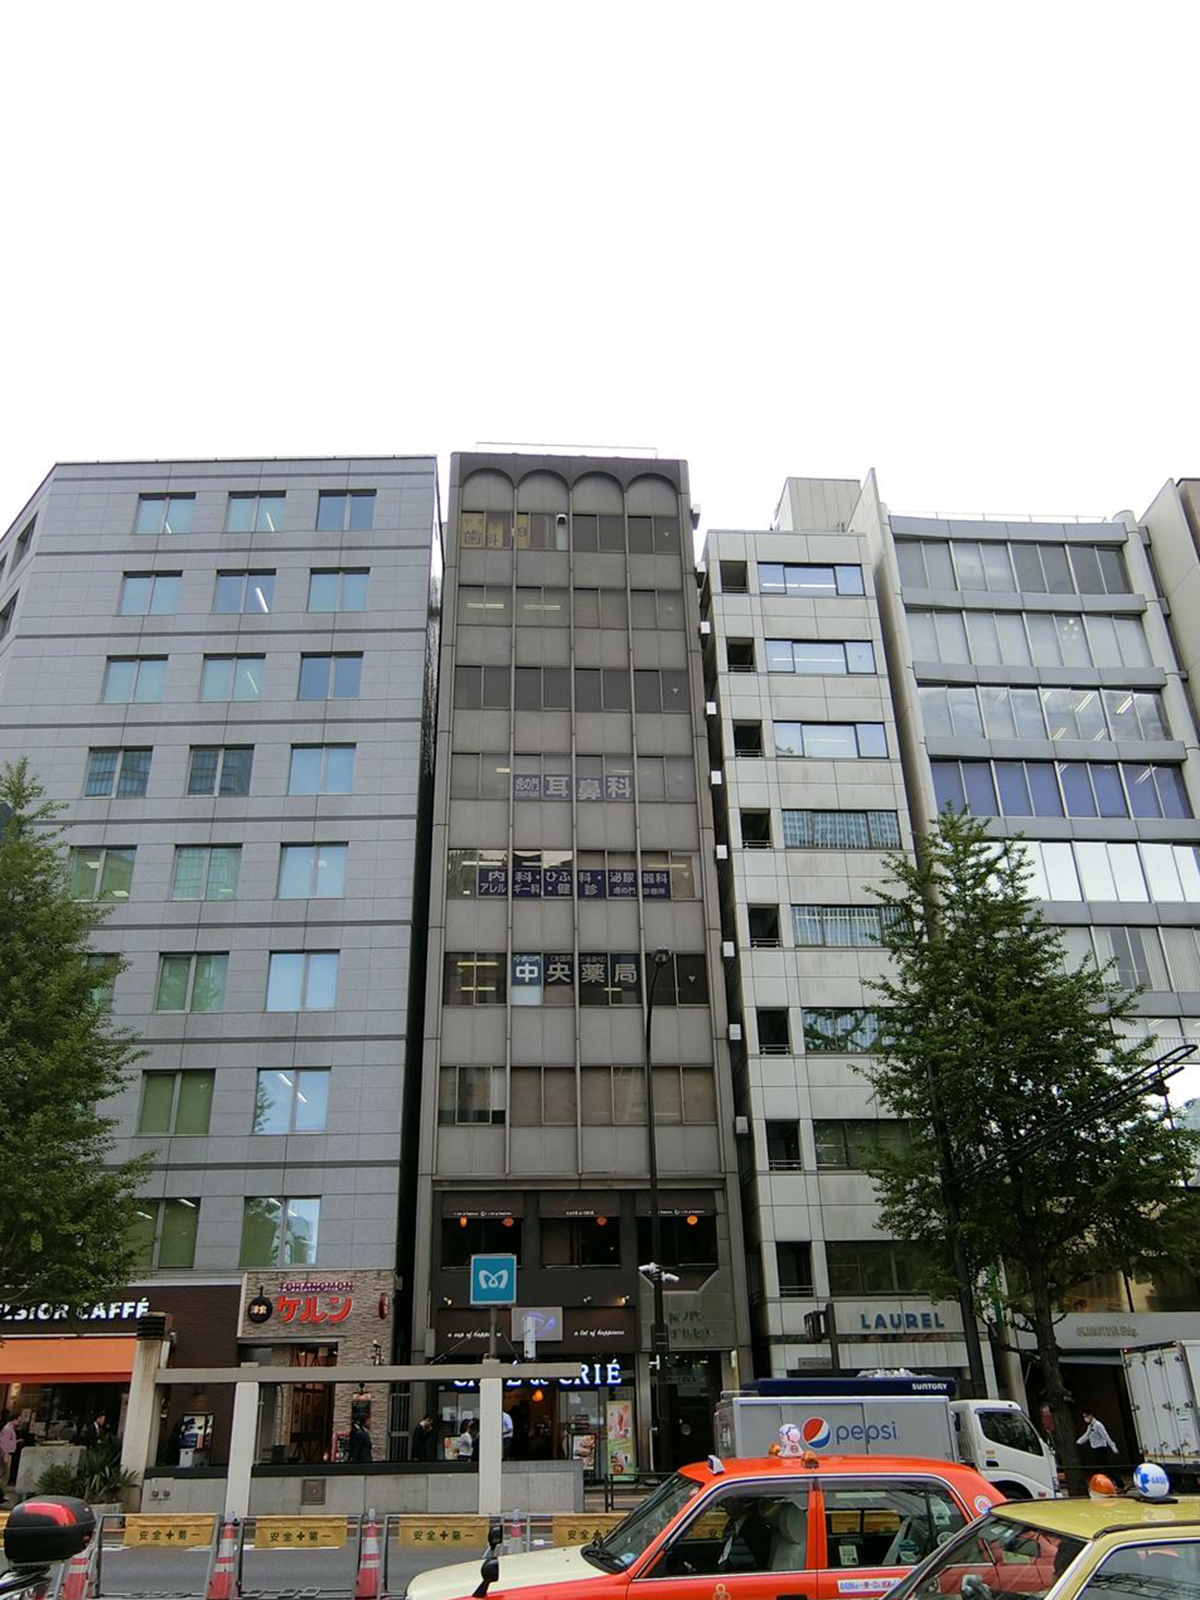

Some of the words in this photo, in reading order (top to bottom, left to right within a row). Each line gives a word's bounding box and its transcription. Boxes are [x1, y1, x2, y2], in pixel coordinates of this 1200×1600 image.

[515, 963, 638, 983] 中央薬局
[277, 1296, 352, 1324] ケルン
[860, 1312, 945, 1330] LAUREL
[911, 1382, 948, 1391] SUNTORY
[836, 1421, 897, 1445] pepsi
